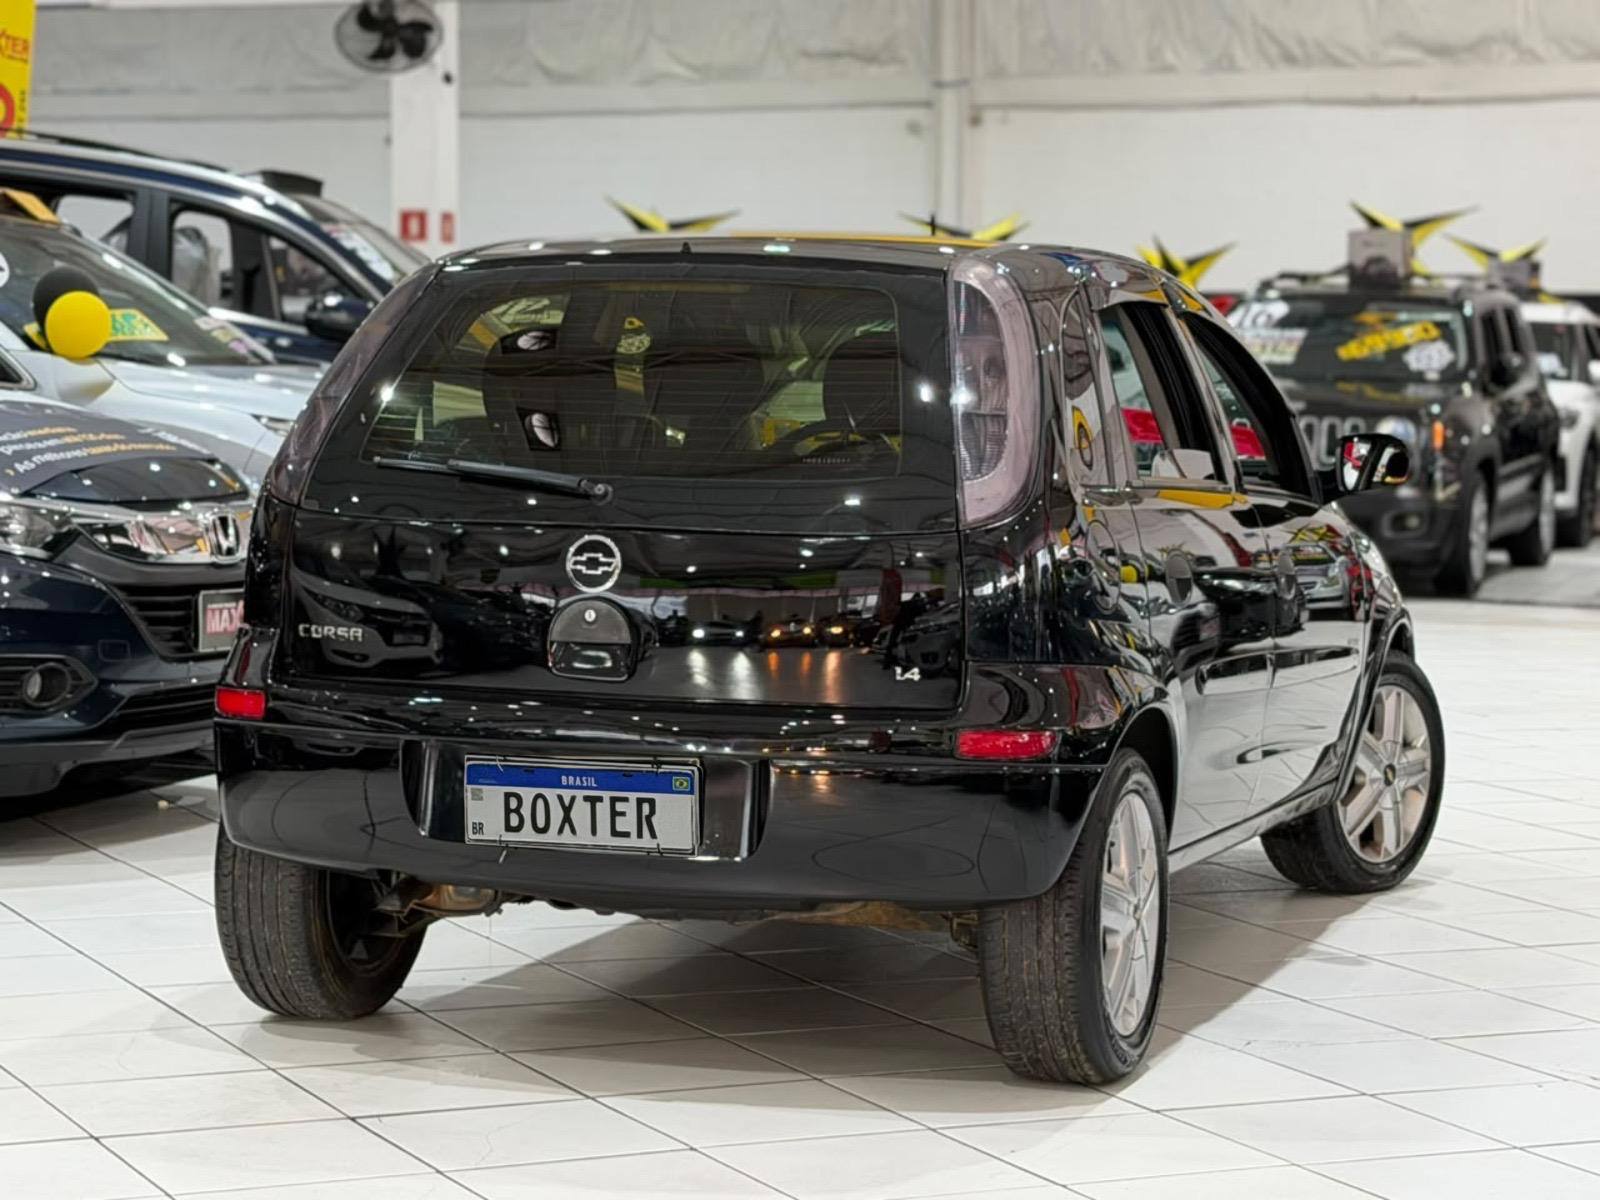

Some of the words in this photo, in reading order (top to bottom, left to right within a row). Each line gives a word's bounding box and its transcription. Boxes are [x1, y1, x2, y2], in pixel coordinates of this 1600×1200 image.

[298, 623, 363, 642] CORSA
[561, 775, 598, 787] BRASIL
[503, 791, 658, 840] BOXTER
[472, 821, 485, 836] BR
